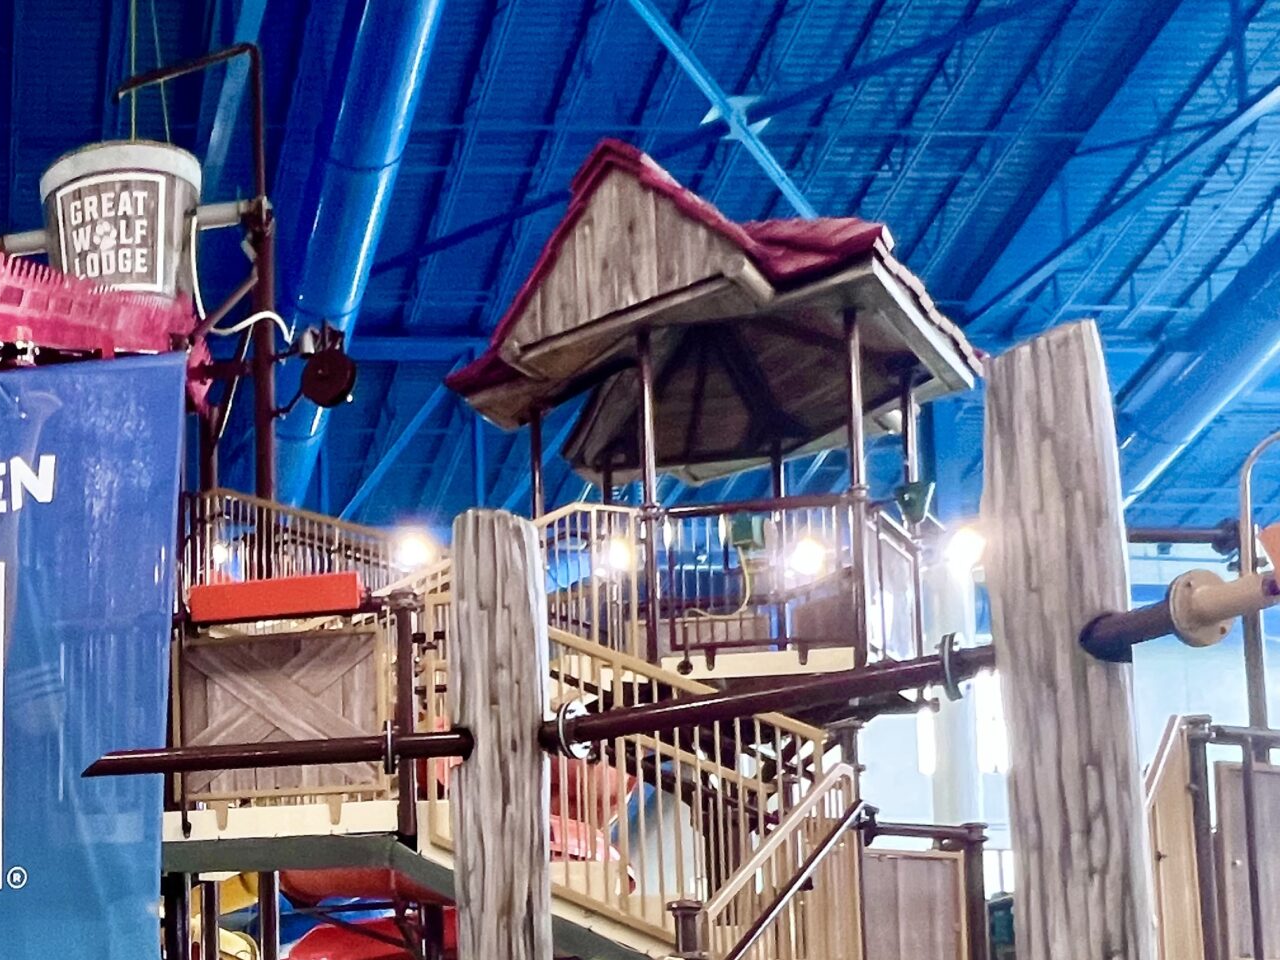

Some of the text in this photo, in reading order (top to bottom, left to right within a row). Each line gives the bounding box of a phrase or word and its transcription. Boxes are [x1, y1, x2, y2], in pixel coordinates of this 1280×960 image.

[70, 190, 149, 226] GREAT
[72, 219, 148, 254] WLF
[74, 248, 148, 281] LODGE
